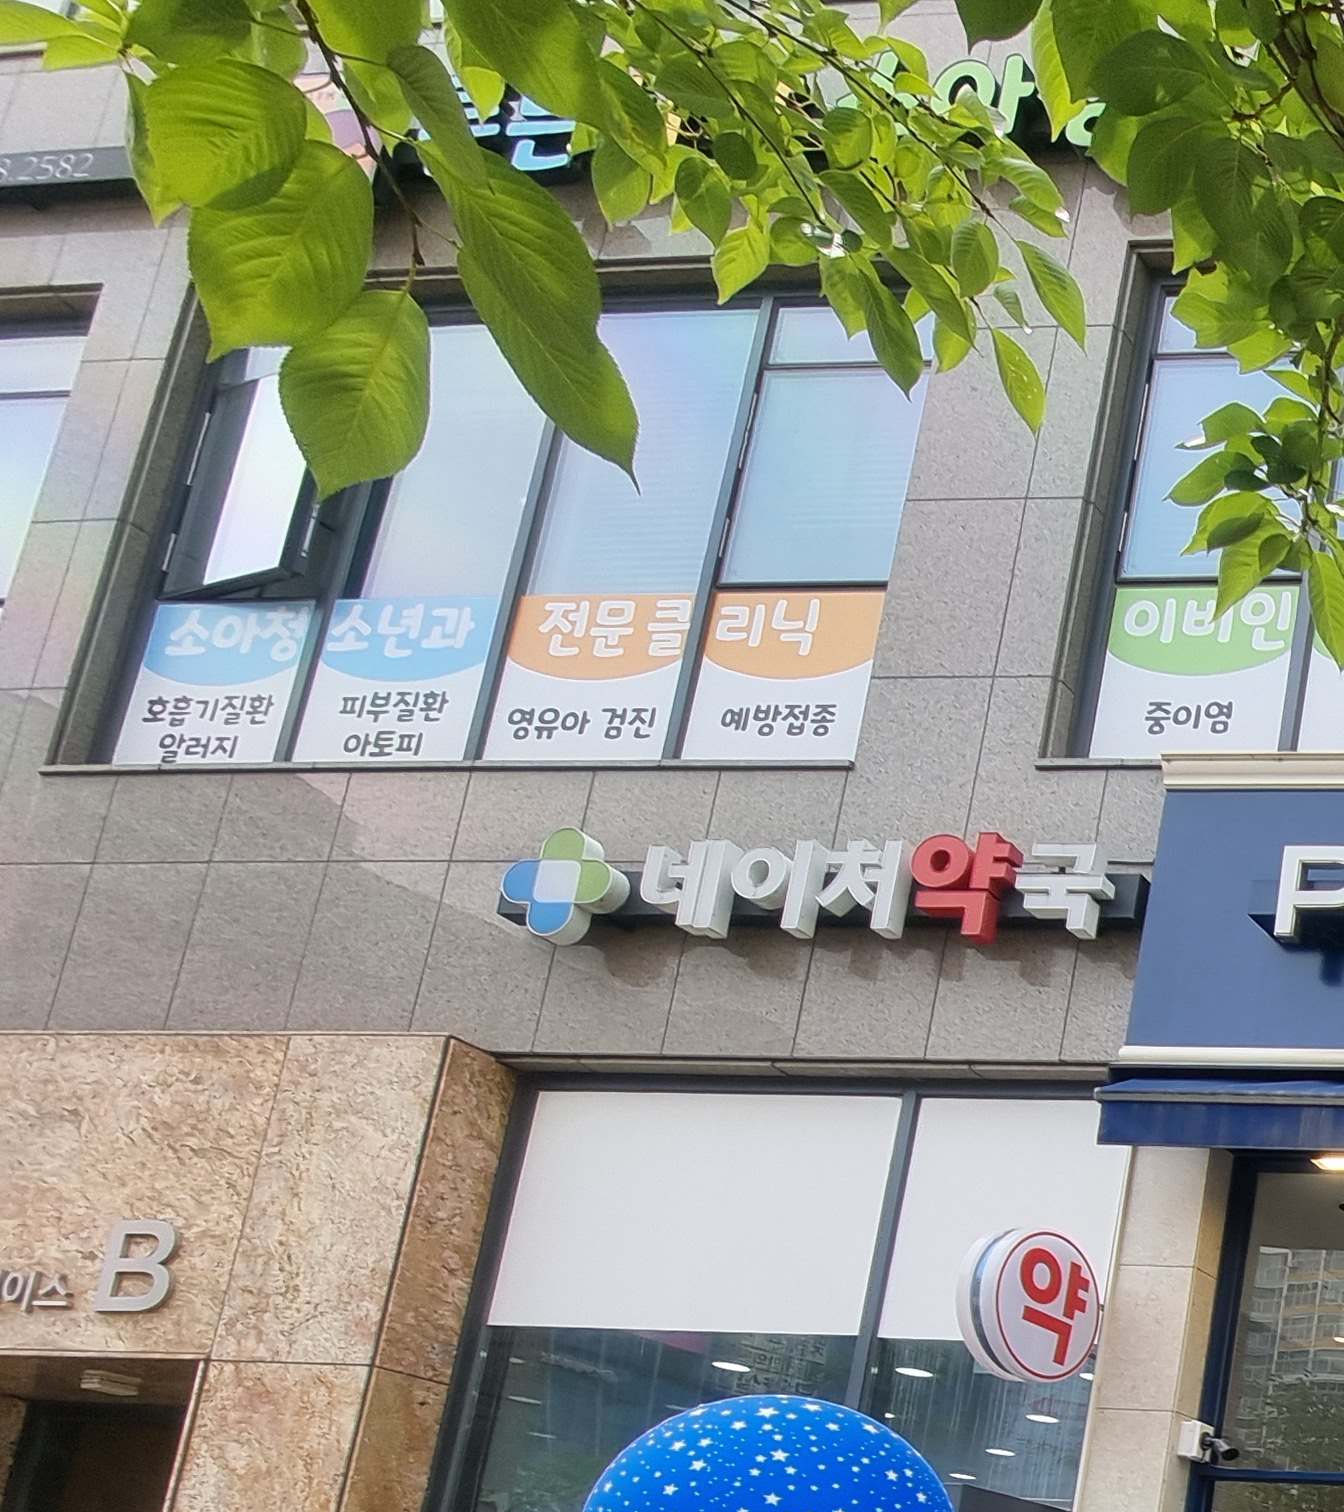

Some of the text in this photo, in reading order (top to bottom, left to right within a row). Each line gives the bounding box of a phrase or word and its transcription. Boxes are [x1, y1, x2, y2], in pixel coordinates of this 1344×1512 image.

[539, 600, 635, 657] 전문
[142, 695, 273, 726] 호흡기질환
[339, 691, 448, 723] 피부질환
[508, 707, 657, 740] 영유아 검진
[721, 704, 837, 737] 예방접종
[1144, 701, 1233, 735] 중이염
[159, 733, 238, 763] 알러지
[343, 730, 423, 757] 아토피
[640, 833, 1115, 942] 네이처약국
[95, 1219, 181, 1312] B
[1019, 1247, 1090, 1366] 약
